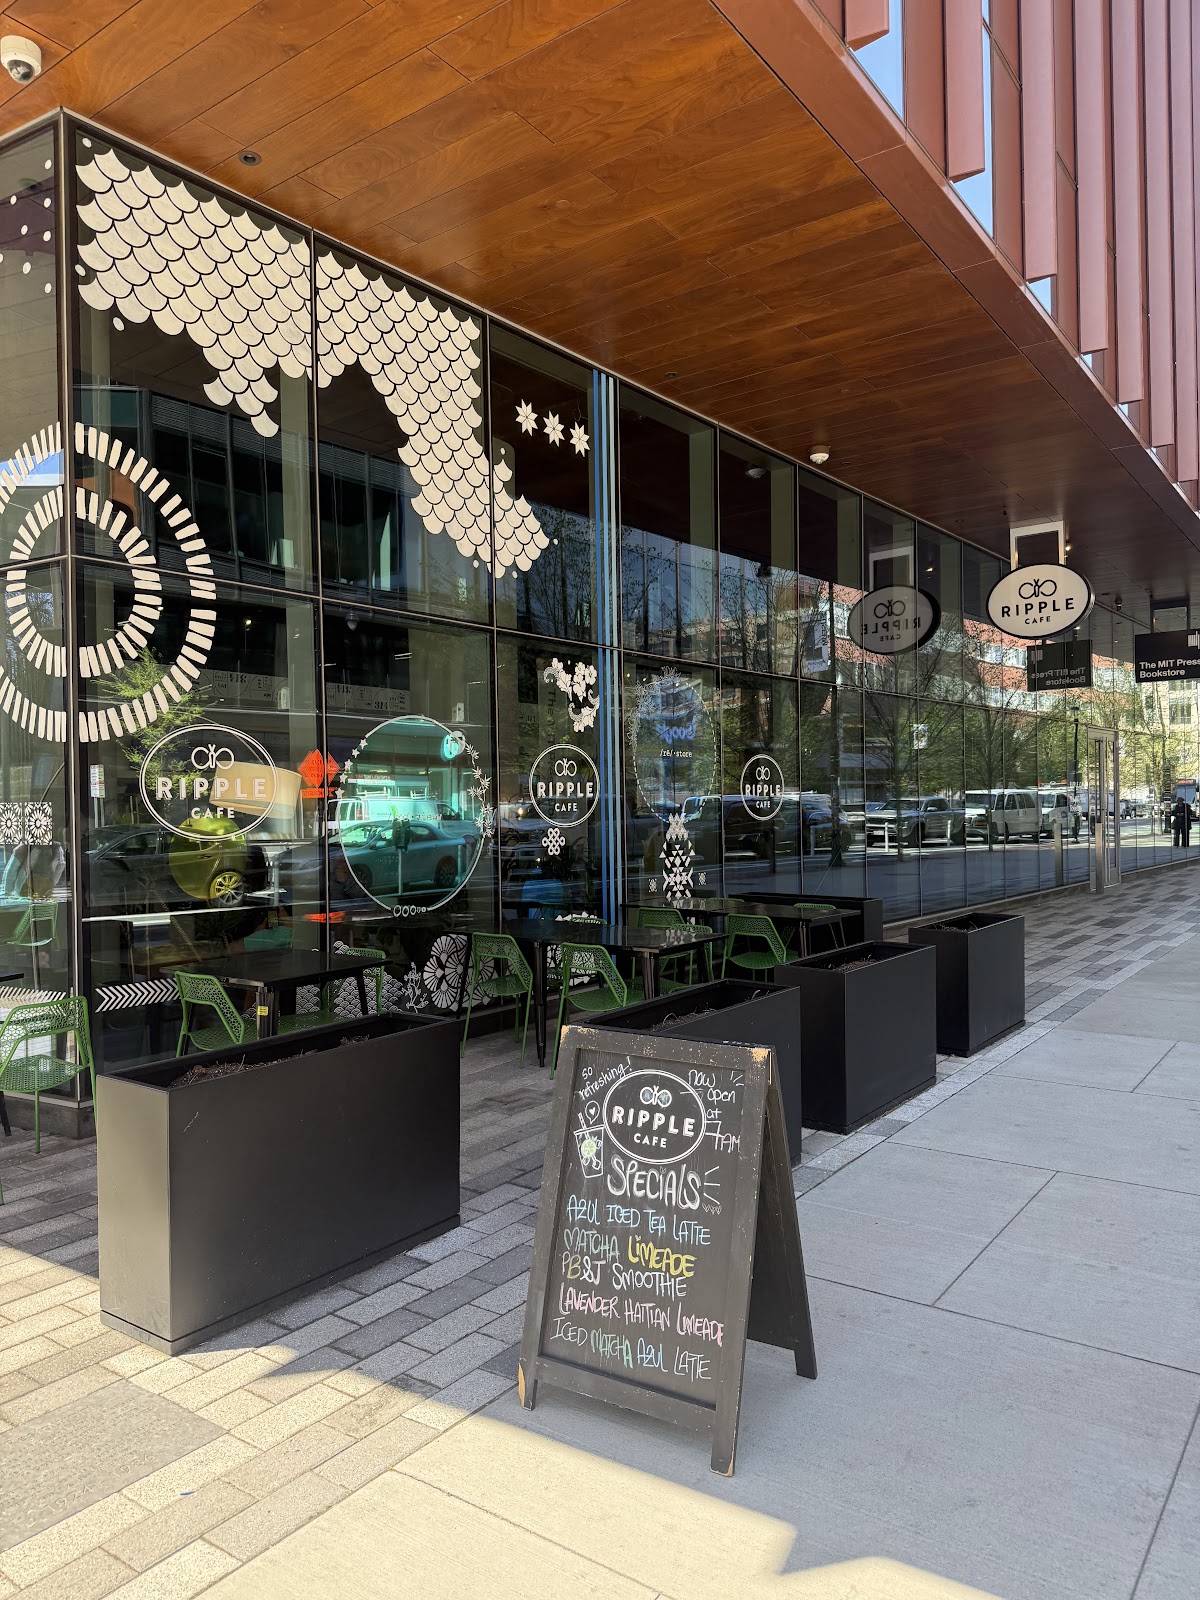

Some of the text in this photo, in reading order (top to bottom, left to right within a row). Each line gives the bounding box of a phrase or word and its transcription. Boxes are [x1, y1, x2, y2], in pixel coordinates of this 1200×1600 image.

[1001, 598, 1075, 617] RIPPLE
[1024, 616, 1051, 624] CAFE
[1139, 661, 1157, 670] The
[1158, 660, 1175, 668] MIT
[1140, 669, 1186, 679] Bookstore
[155, 777, 267, 800] RIPPLE
[537, 781, 594, 798] RIPPLE
[745, 784, 781, 798] RIPPLE
[191, 807, 235, 819] CAFE
[555, 802, 578, 812] CAFE
[611, 1105, 696, 1138] RIPPLE
[706, 1108, 722, 1119] at
[633, 1132, 668, 1149] CAFE
[567, 1194, 711, 1246] AZUL ICED TEA LATTE
[564, 1227, 621, 1262] MATCHA
[612, 1263, 688, 1302] SMOOTHIE
[559, 1282, 621, 1319] LAVENDER
[550, 1316, 712, 1382] ICED MATCHA AZUL LATTE
